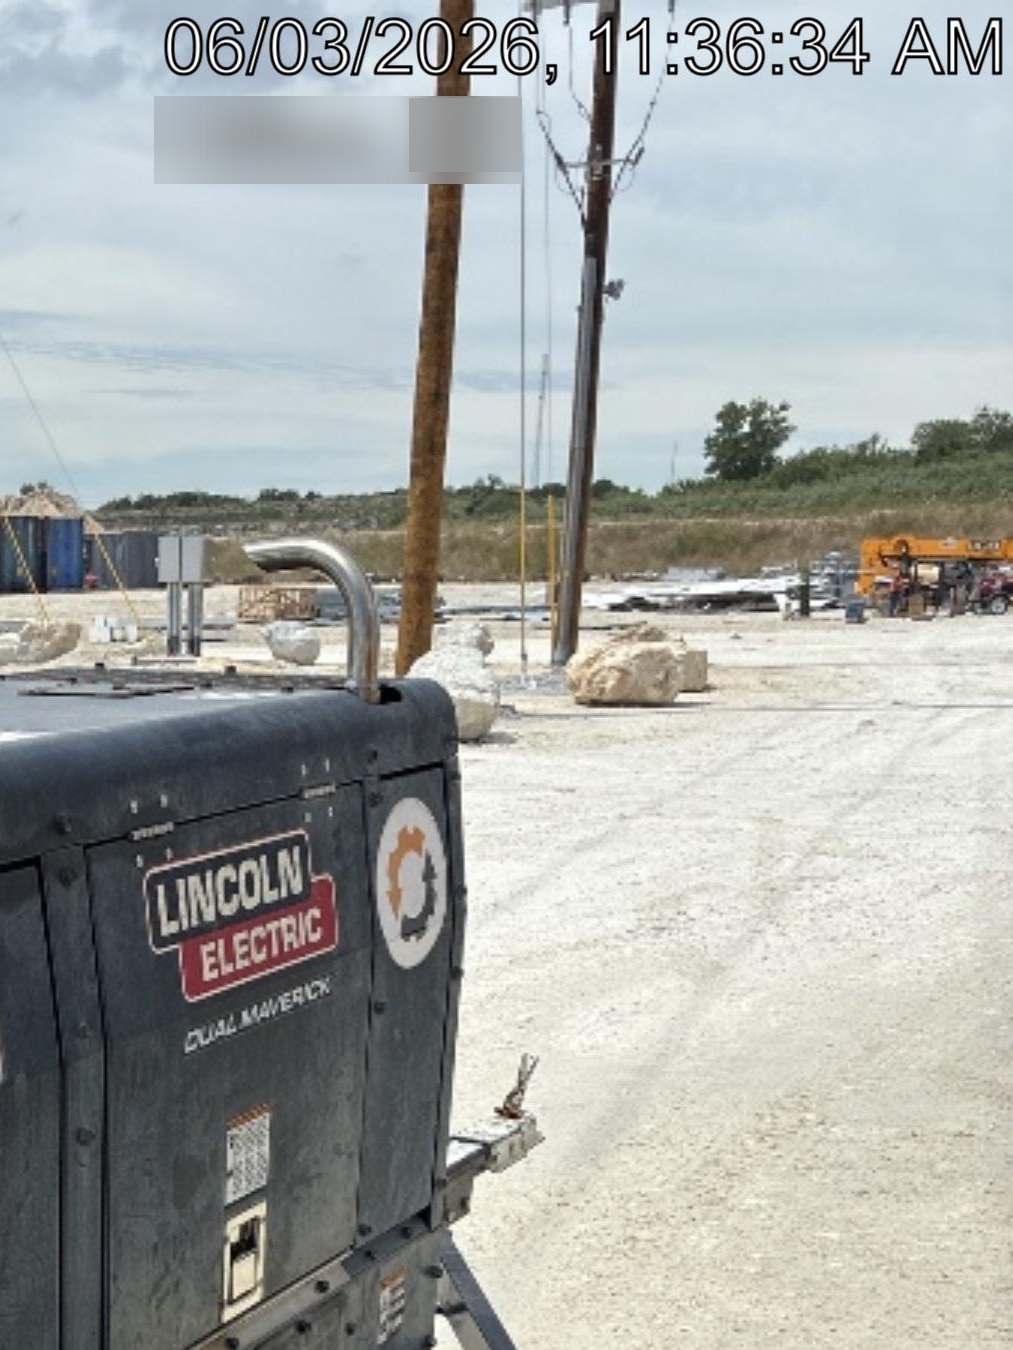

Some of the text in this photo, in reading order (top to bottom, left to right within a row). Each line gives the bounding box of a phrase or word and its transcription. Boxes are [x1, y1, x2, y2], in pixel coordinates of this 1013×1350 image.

[156, 845, 304, 937] LINCOLN
[199, 907, 324, 982] ELECTRIC
[184, 977, 334, 1054] DUAL MAVERICK
